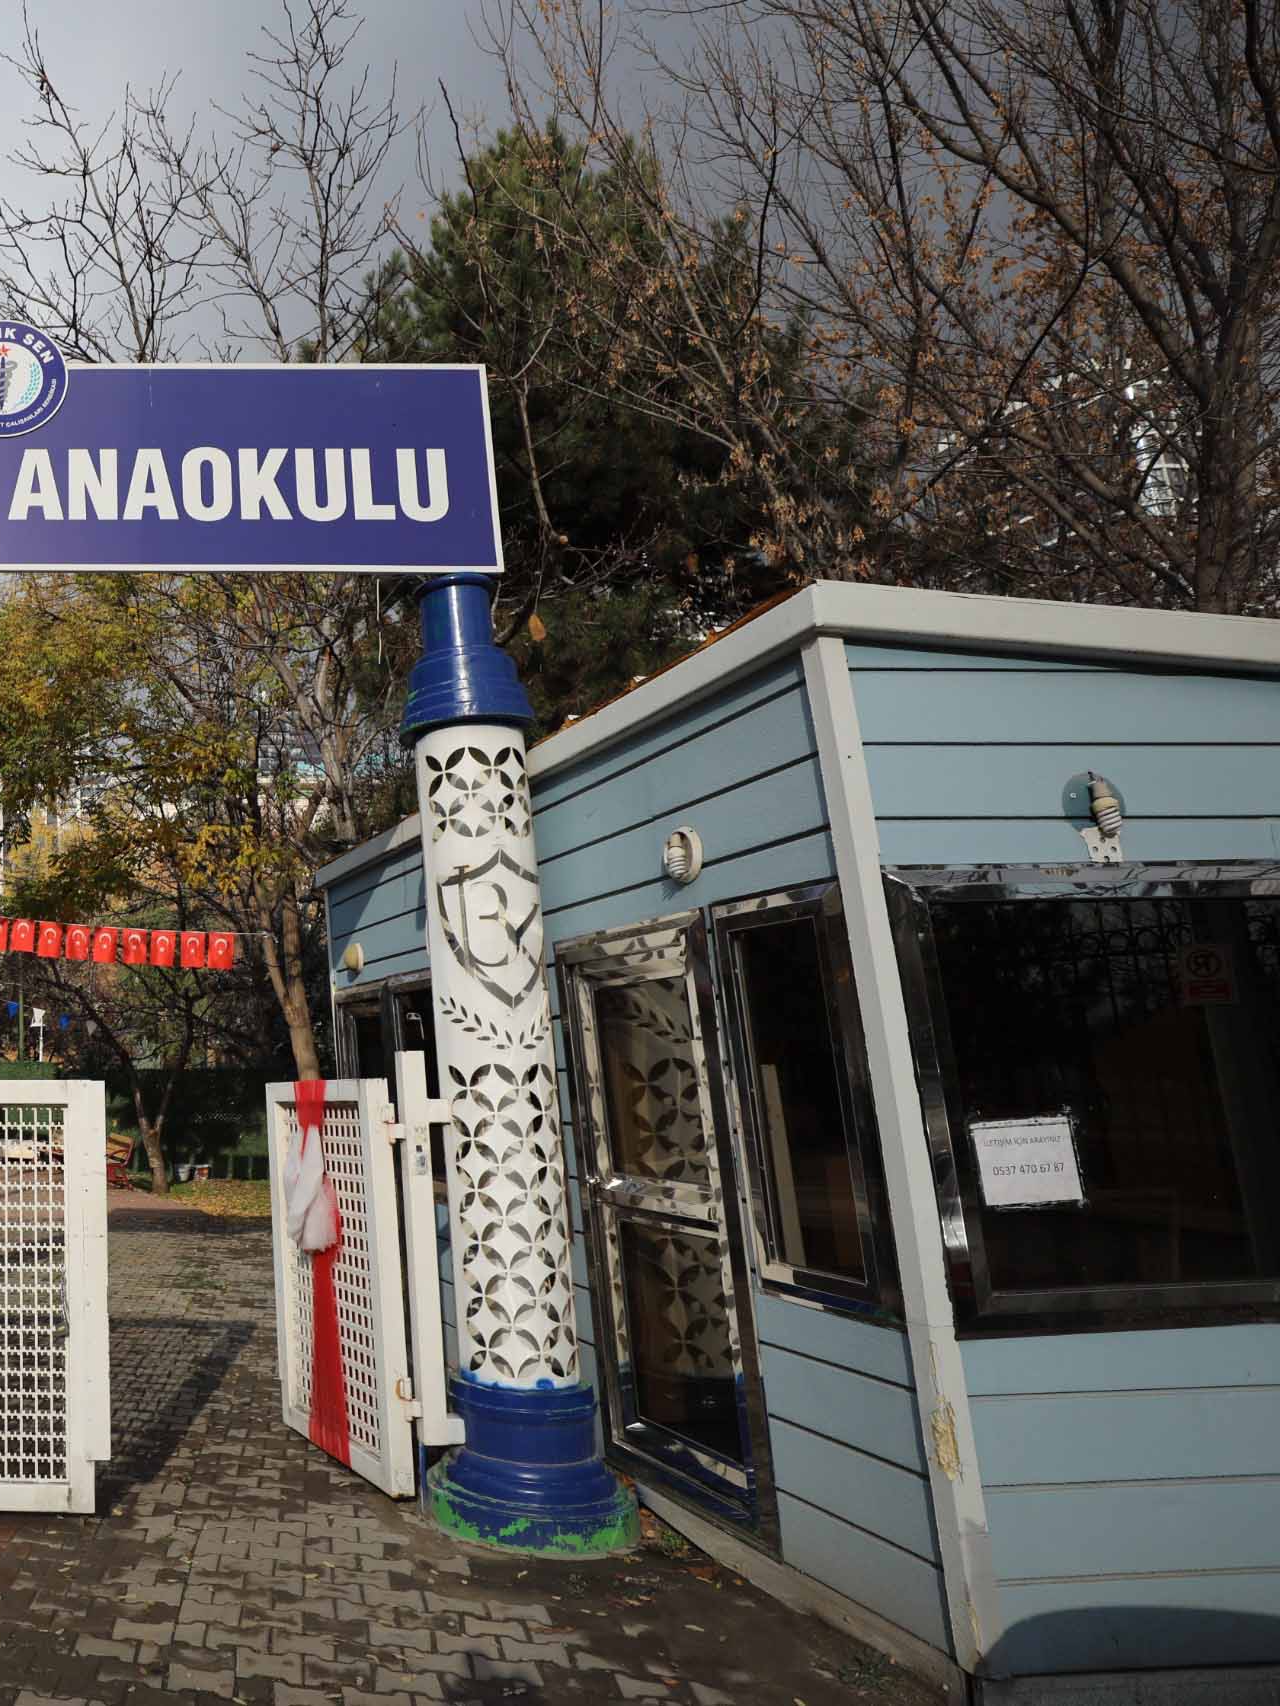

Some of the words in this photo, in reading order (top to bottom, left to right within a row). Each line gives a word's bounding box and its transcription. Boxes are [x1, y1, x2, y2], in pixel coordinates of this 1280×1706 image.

[22, 333, 54, 364] SEN
[8, 445, 449, 523] ANAOKULU
[992, 1165, 1016, 1176] 0537
[1019, 1164, 1038, 1175] 470
